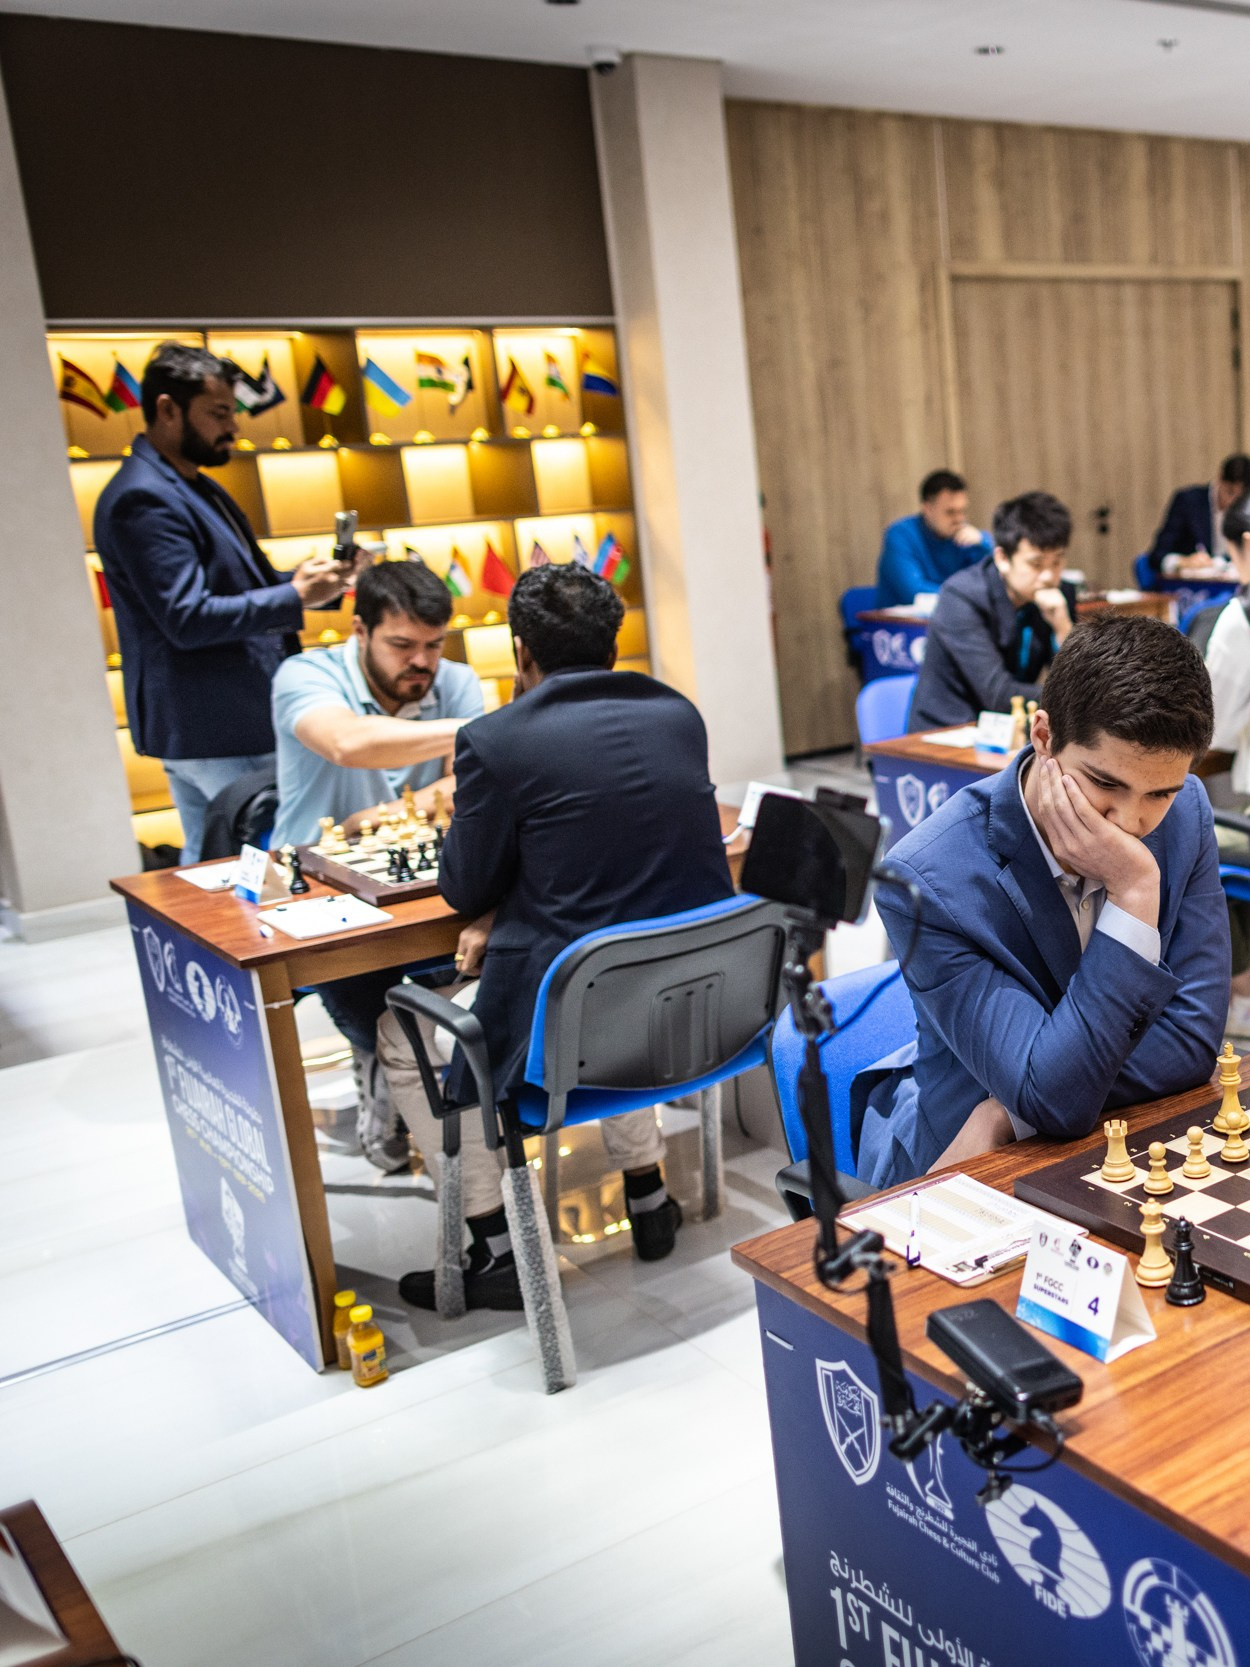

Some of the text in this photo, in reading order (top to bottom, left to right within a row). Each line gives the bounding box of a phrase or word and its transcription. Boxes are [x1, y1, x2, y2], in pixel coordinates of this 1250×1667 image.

[1033, 1283, 1069, 1306] SUPERSTARS
[1043, 1275, 1065, 1293] FGCC
[1087, 1296, 1100, 1317] 4
[888, 1499, 918, 1528] Fujairah
[918, 1520, 942, 1545] Chess
[942, 1536, 950, 1549] &
[950, 1542, 981, 1571] Culture
[981, 1563, 1001, 1585] Club
[829, 1550, 914, 1627] للشطرنج
[1034, 1585, 1071, 1620] FIDE
[829, 1586, 871, 1651] 1ST
